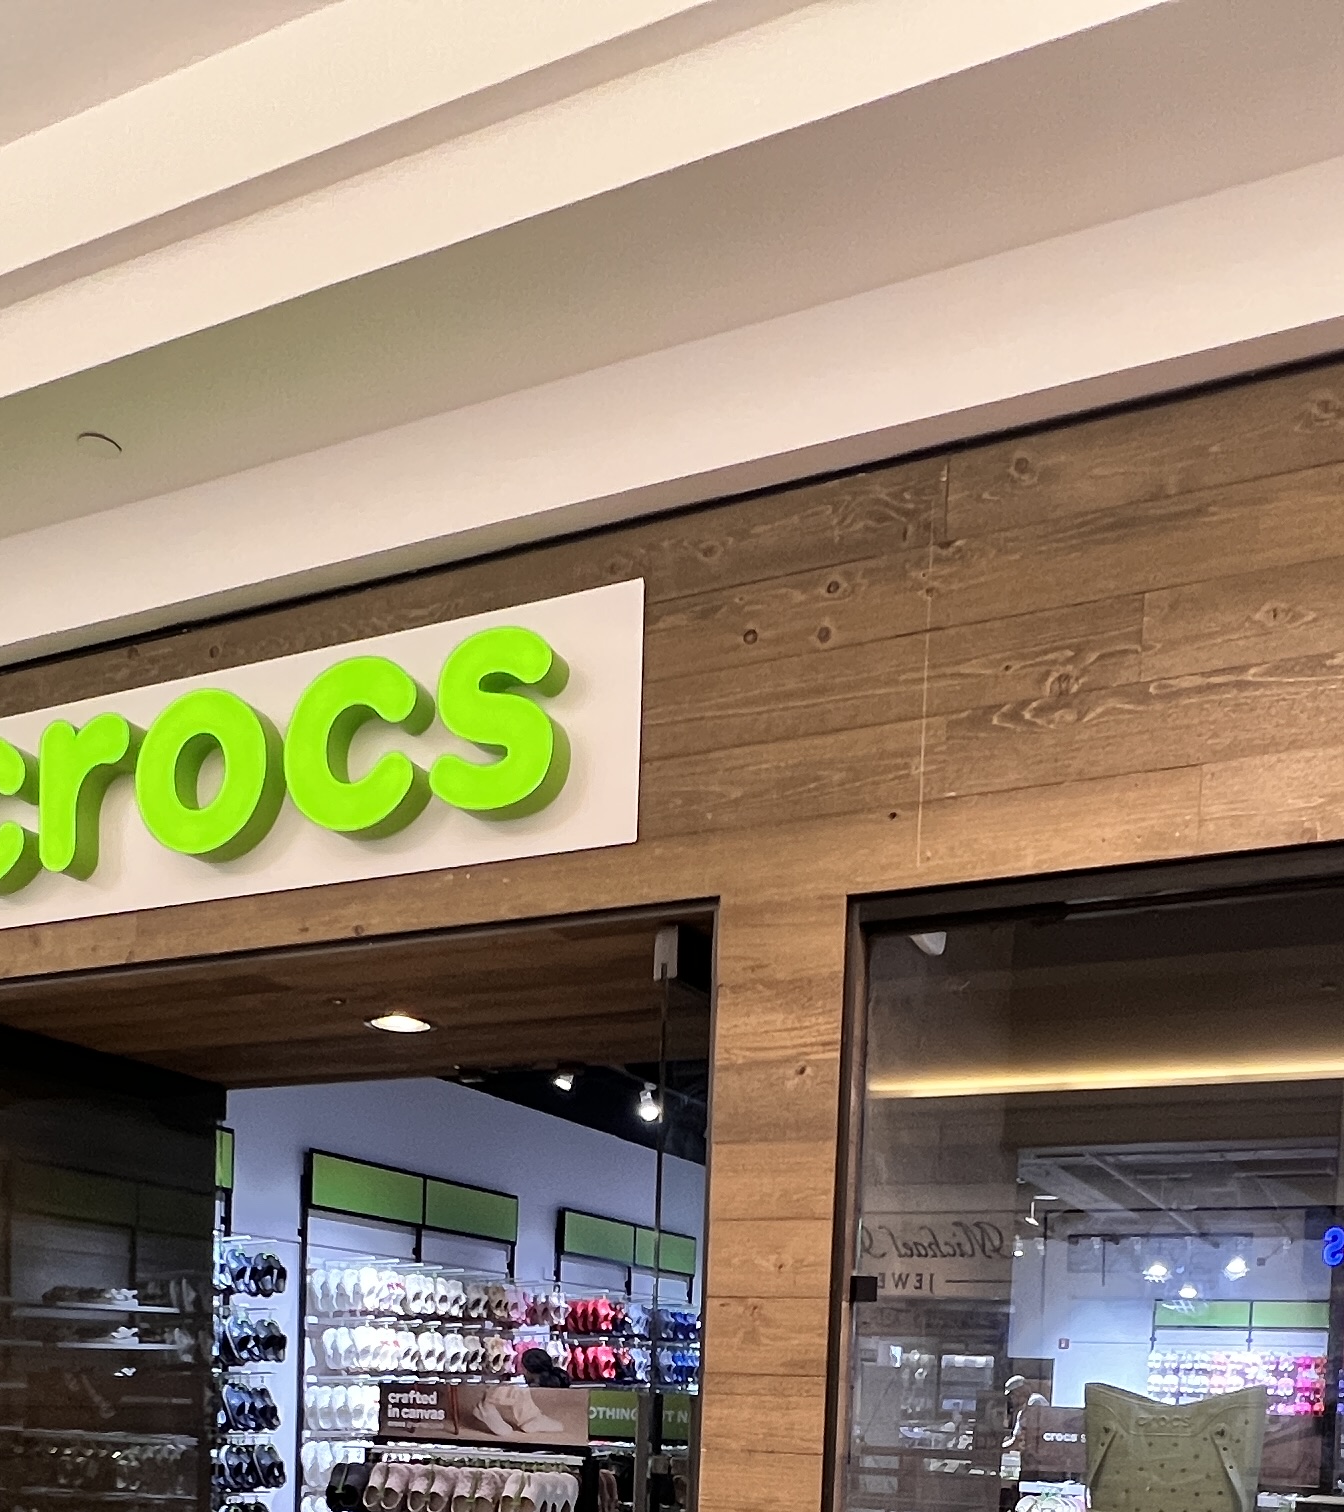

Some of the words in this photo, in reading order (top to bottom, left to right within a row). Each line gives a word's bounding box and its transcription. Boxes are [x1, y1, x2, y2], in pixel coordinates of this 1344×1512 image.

[388, 1390, 437, 1405] crafted
[387, 1404, 400, 1418] in
[401, 1408, 445, 1420] canvas
